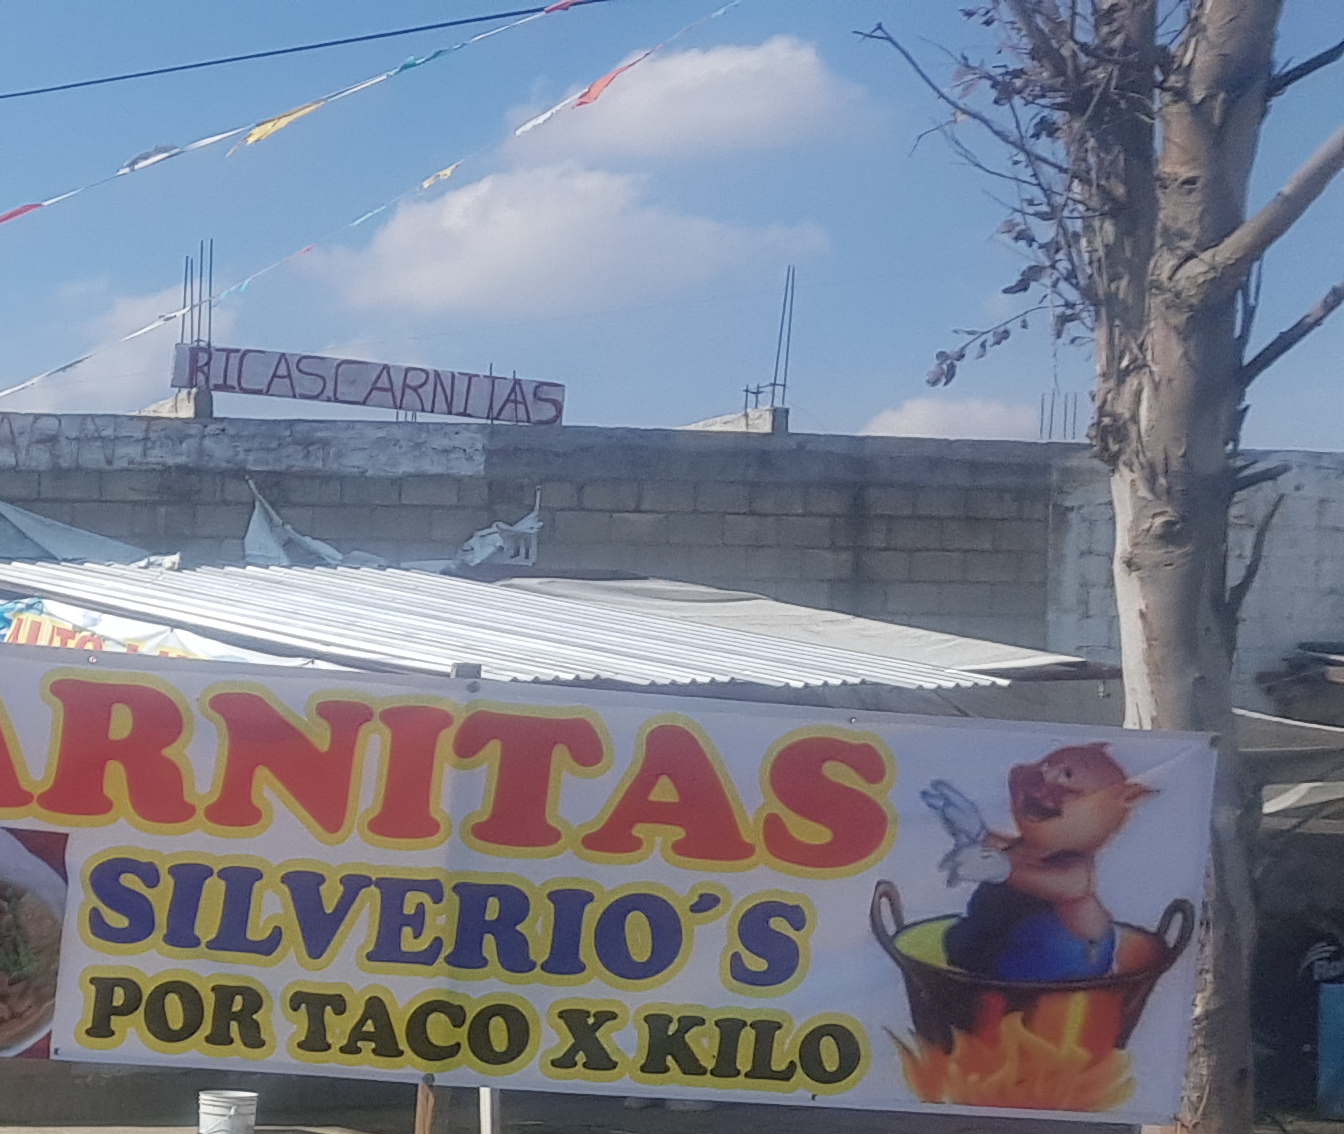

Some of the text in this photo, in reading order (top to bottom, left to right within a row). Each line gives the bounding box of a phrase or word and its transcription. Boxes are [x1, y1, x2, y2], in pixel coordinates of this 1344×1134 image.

[333, 358, 566, 425] CARNITAS
[87, 857, 808, 987] SILVERIO'S
[84, 976, 862, 1086] POR TACO X KILO
